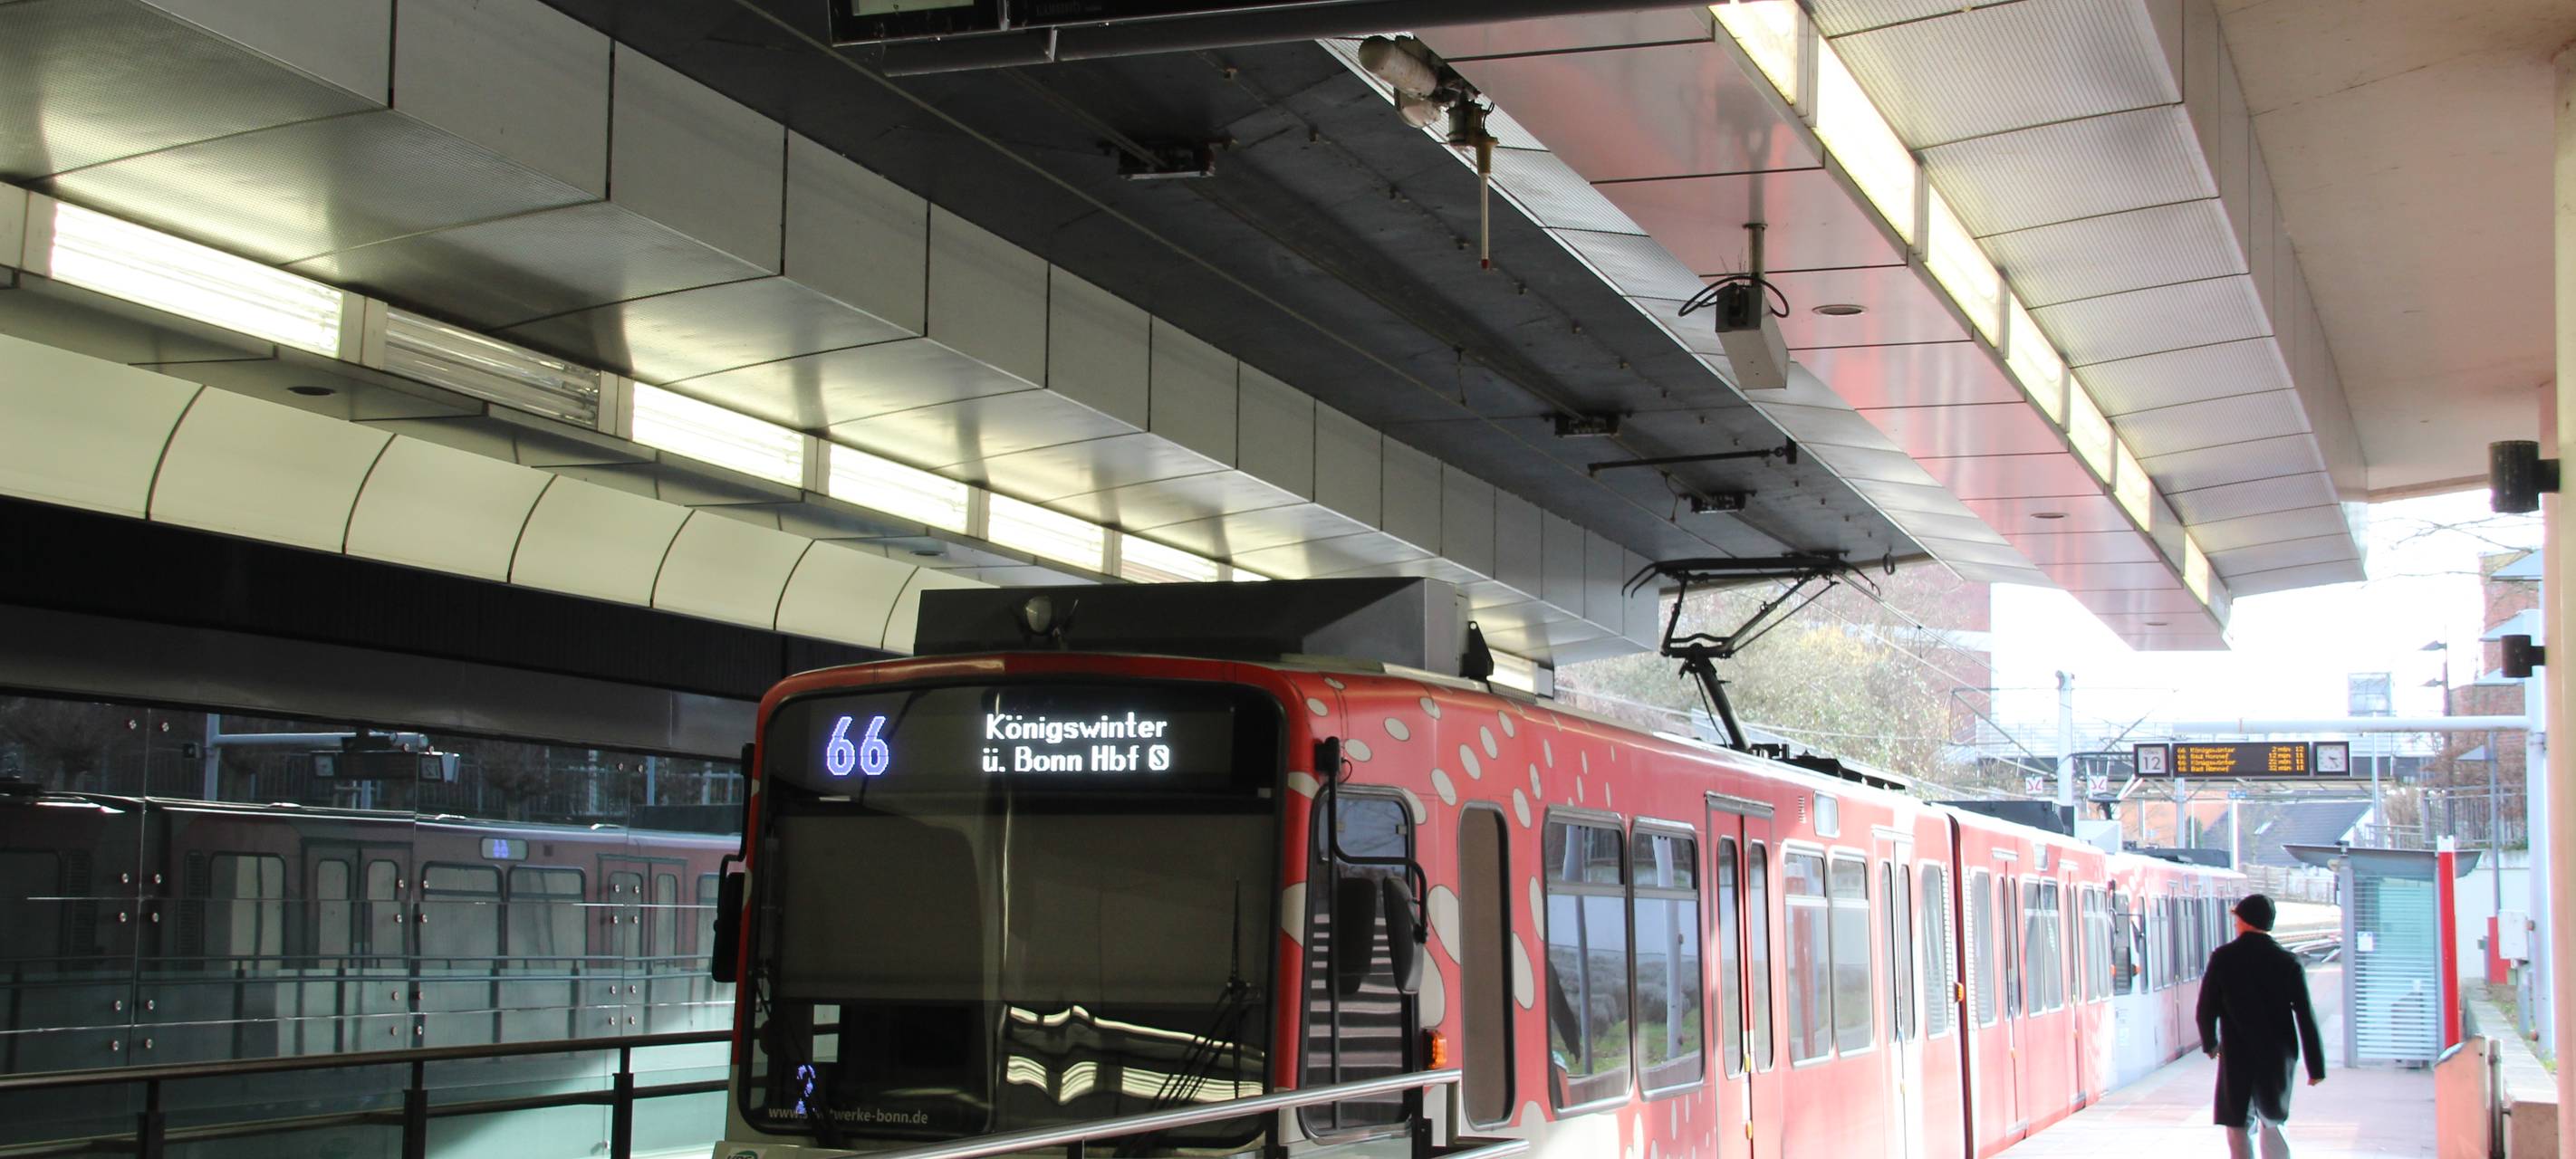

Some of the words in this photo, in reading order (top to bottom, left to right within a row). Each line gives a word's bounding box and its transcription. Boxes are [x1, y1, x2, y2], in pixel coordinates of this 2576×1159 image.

[985, 712, 1168, 744] Königswinter
[825, 714, 889, 776] 66
[983, 748, 1006, 771] ü.
[1014, 745, 1082, 771] Bonn
[1091, 745, 1139, 771] Hbf
[2143, 756, 2161, 771] 12
